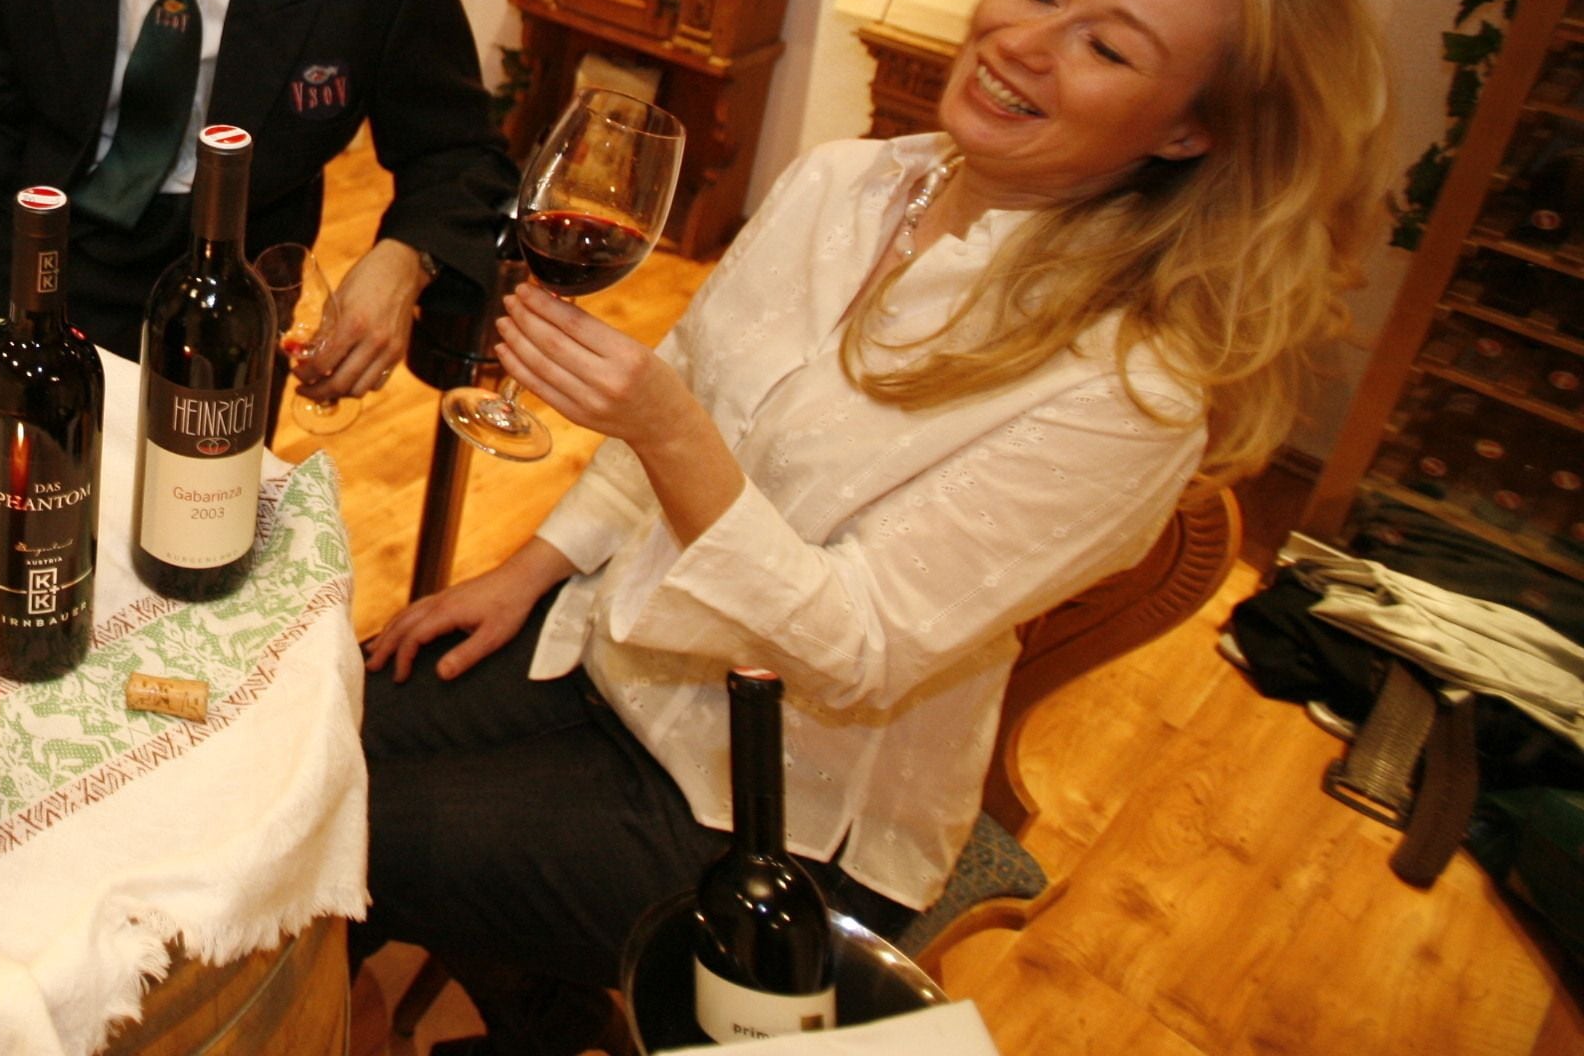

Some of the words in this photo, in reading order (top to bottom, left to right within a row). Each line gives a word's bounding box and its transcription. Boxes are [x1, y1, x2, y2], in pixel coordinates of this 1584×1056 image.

[172, 393, 255, 437] HEINRICH
[34, 481, 62, 494] DAS
[172, 485, 243, 504] Gabarinza
[190, 506, 226, 520] 2003
[26, 556, 63, 566] AUSTRIA
[35, 573, 51, 589] K
[34, 595, 50, 610] K
[732, 1023, 779, 1041] prim
